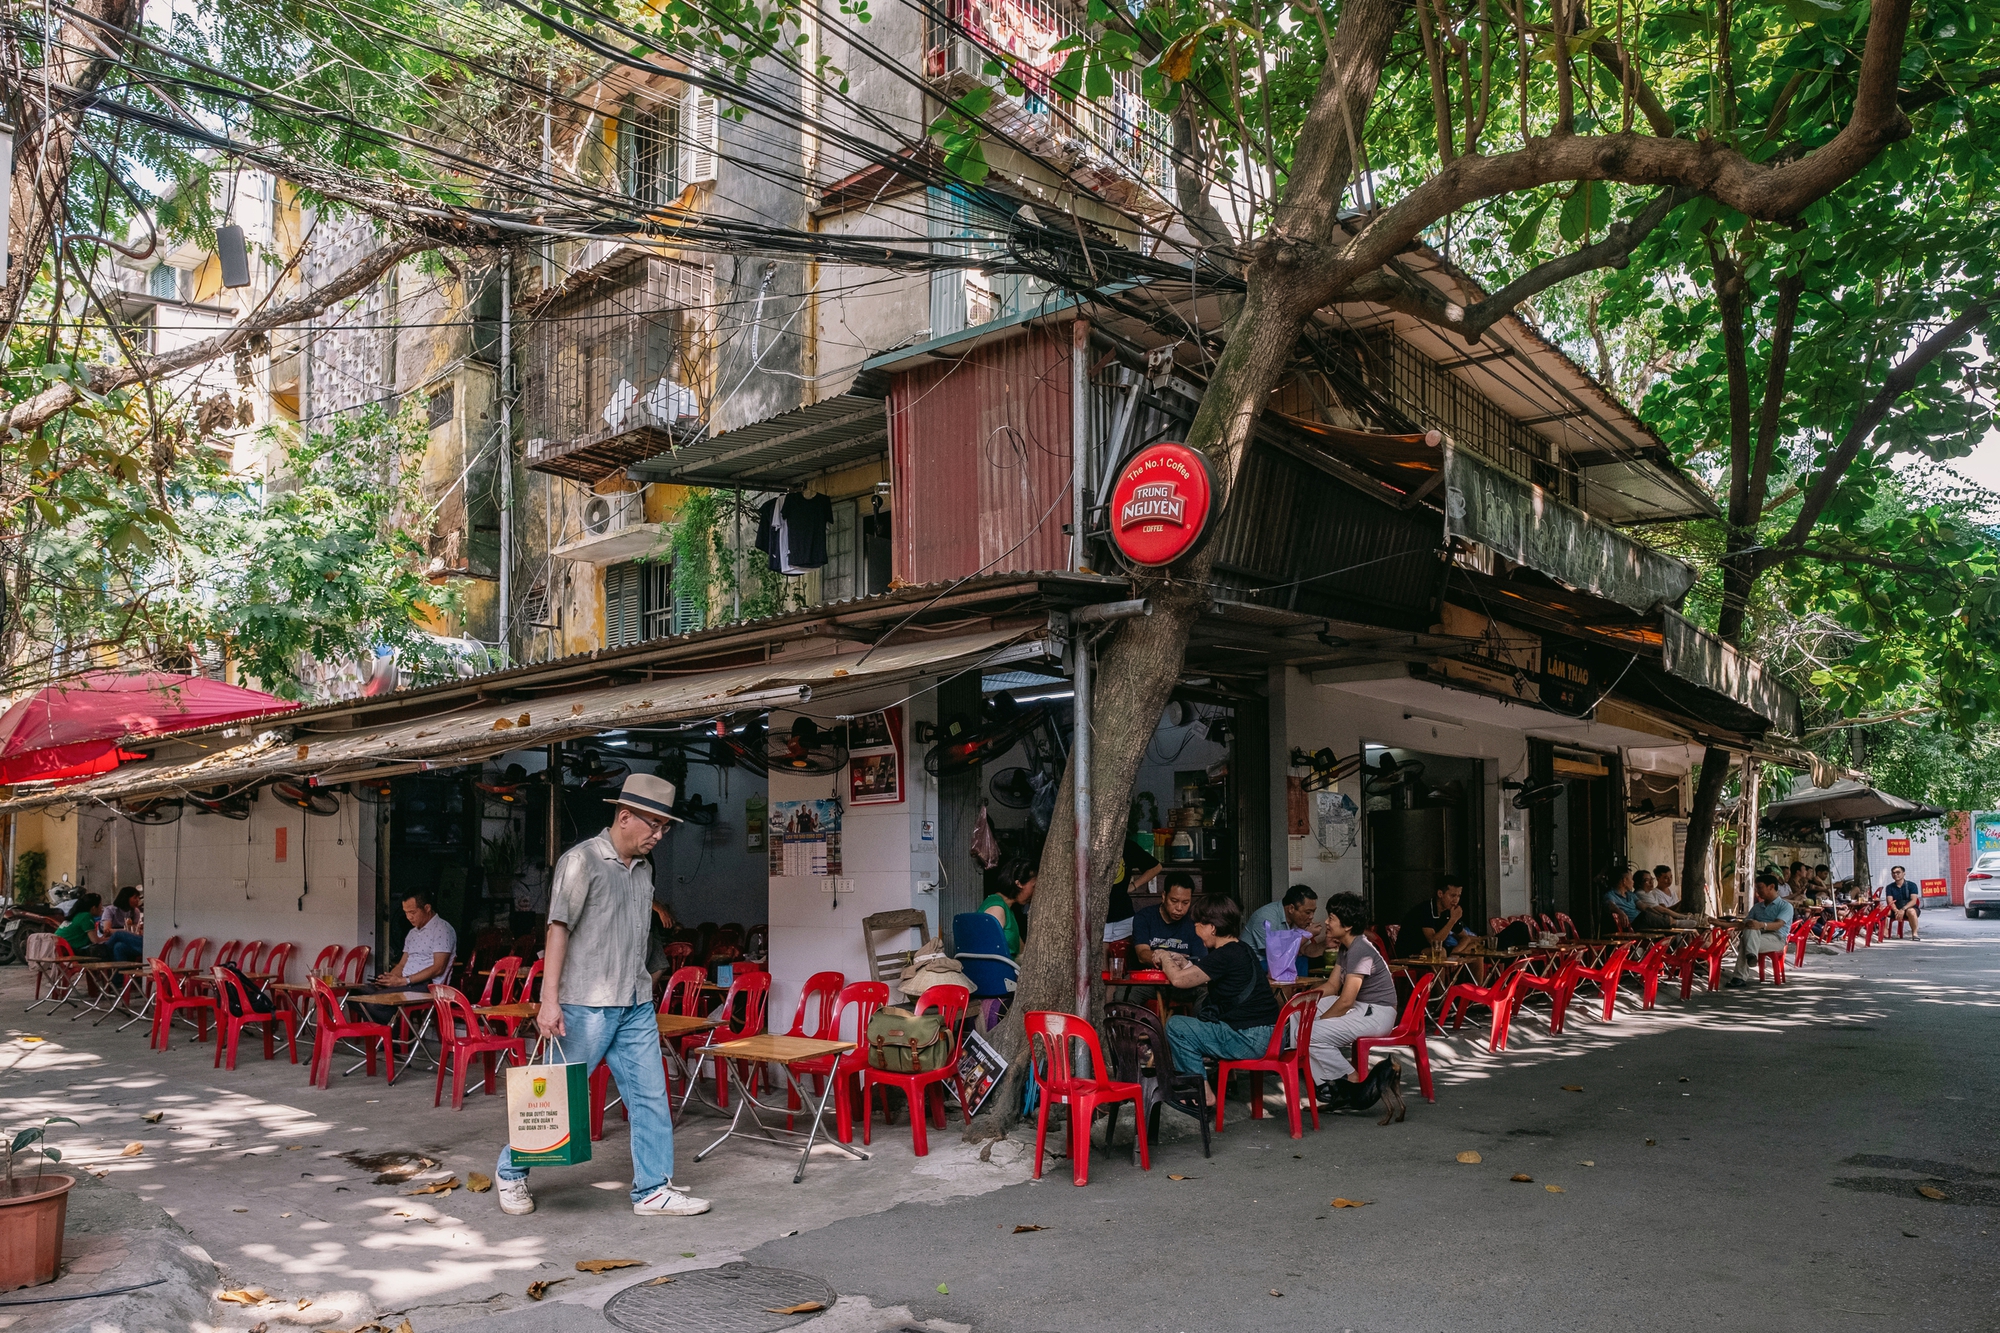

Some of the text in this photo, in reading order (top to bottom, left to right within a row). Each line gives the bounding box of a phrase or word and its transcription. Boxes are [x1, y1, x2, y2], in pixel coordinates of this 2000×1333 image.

[1127, 458, 1190, 481] The No.1 Coffee
[1137, 487, 1168, 499] TRUNG
[1124, 499, 1180, 520] NGUYÊN
[1143, 524, 1164, 533] COFFEE
[1547, 654, 1566, 679] LÂM
[1568, 663, 1589, 686] THAO
[539, 1101, 550, 1109] HỘI
